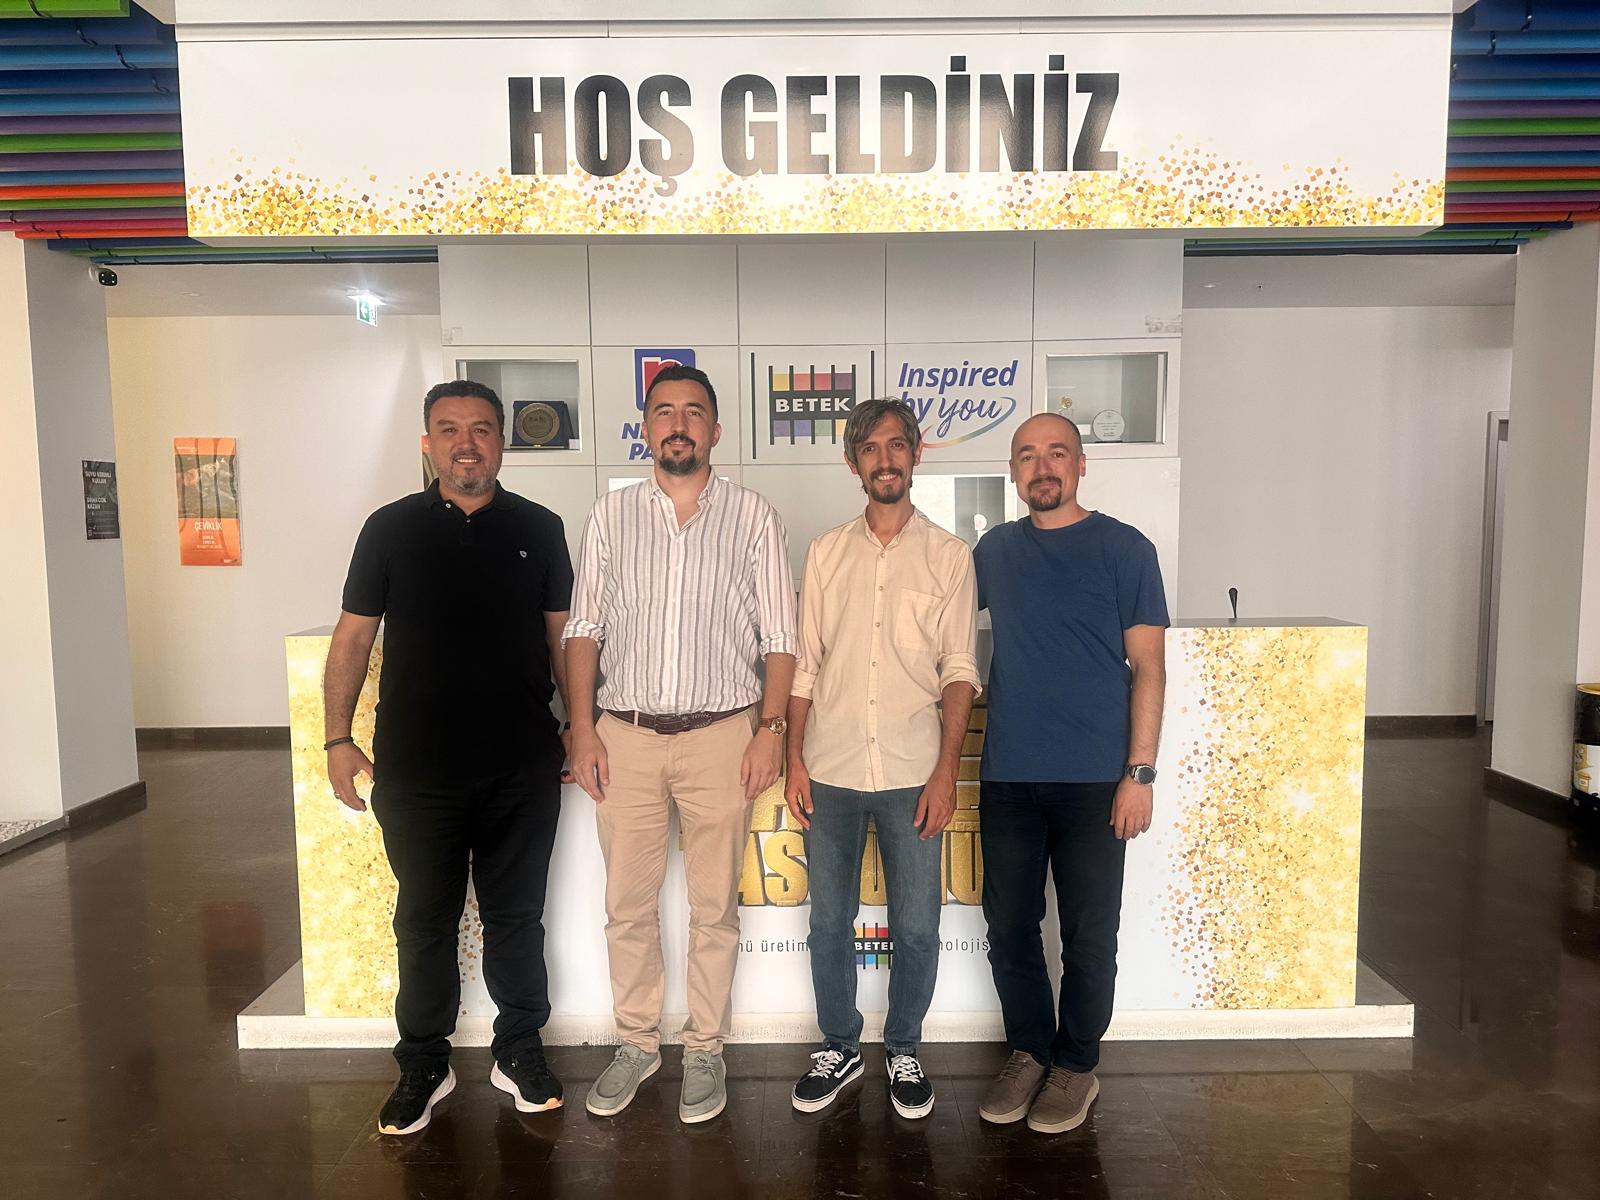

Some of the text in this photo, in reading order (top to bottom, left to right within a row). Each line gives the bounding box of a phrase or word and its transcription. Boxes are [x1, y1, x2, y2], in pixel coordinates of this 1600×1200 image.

[508, 54, 1119, 198] HOŞ GELDİNİZ
[898, 360, 1019, 394] Inspired
[775, 397, 851, 413] BETEK
[937, 396, 1002, 438] you
[761, 940, 809, 952] üretim
[939, 938, 990, 953] nolojis
